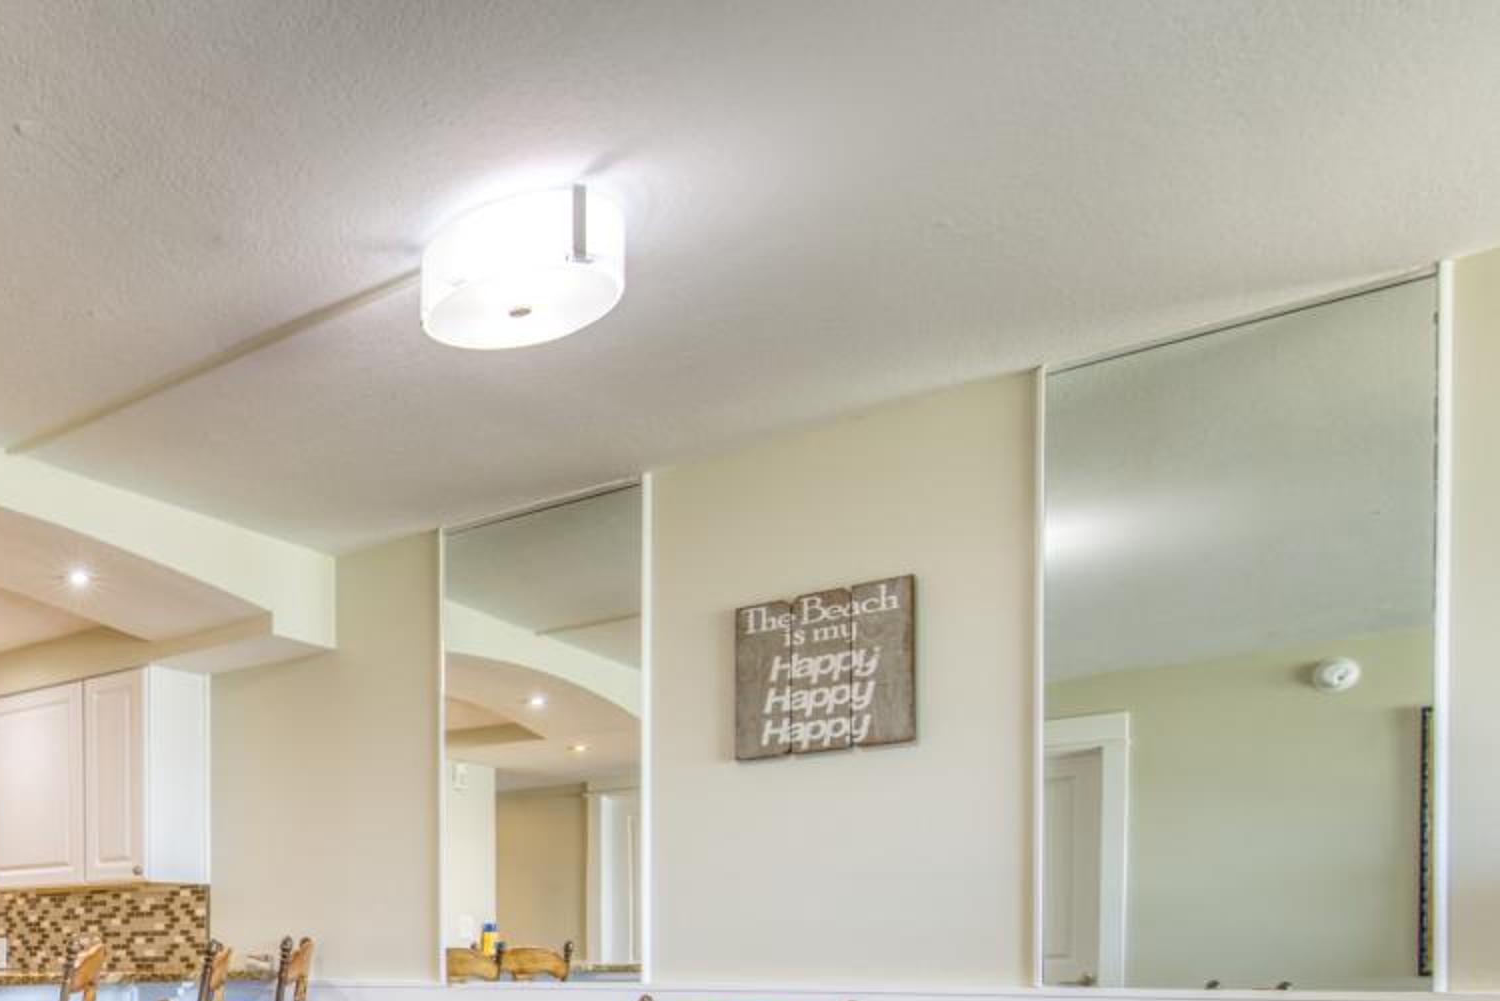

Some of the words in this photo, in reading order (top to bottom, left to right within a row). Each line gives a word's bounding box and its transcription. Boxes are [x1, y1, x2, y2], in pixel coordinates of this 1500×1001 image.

[742, 607, 796, 634] The
[801, 584, 900, 625] Beach
[783, 629, 805, 647] is
[813, 622, 858, 643] my
[769, 646, 882, 684] Happy
[763, 679, 876, 717] Happy
[761, 713, 872, 749] Happy
